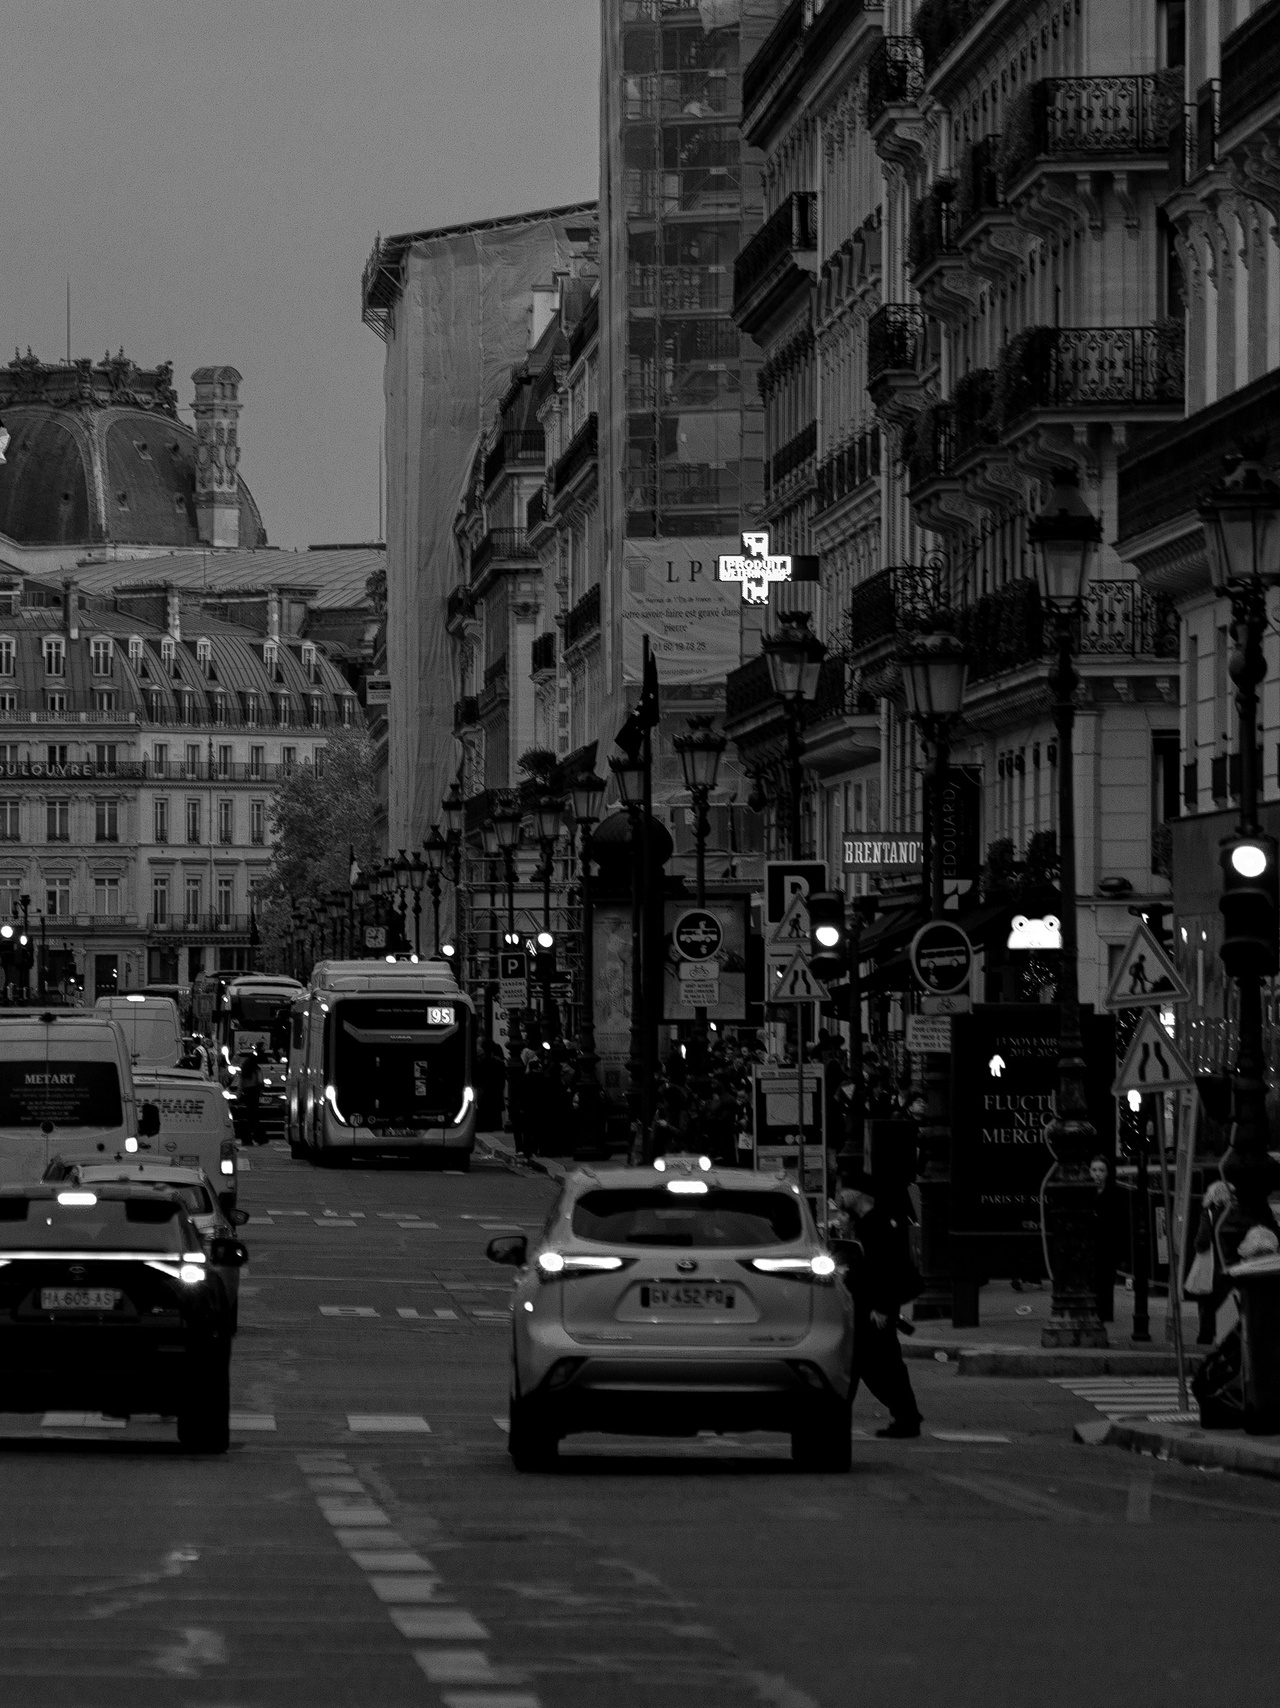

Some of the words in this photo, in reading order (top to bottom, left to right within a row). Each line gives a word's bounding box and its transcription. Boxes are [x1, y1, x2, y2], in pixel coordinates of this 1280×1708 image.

[20, 764, 92, 777] LOUVRE
[844, 841, 924, 863] BRENTANO'
[507, 959, 519, 975] P
[431, 1008, 451, 1024] 95
[1008, 1037, 1059, 1047] NOVEMB
[24, 1073, 76, 1085] METART
[982, 1128, 1046, 1144] MERGI
